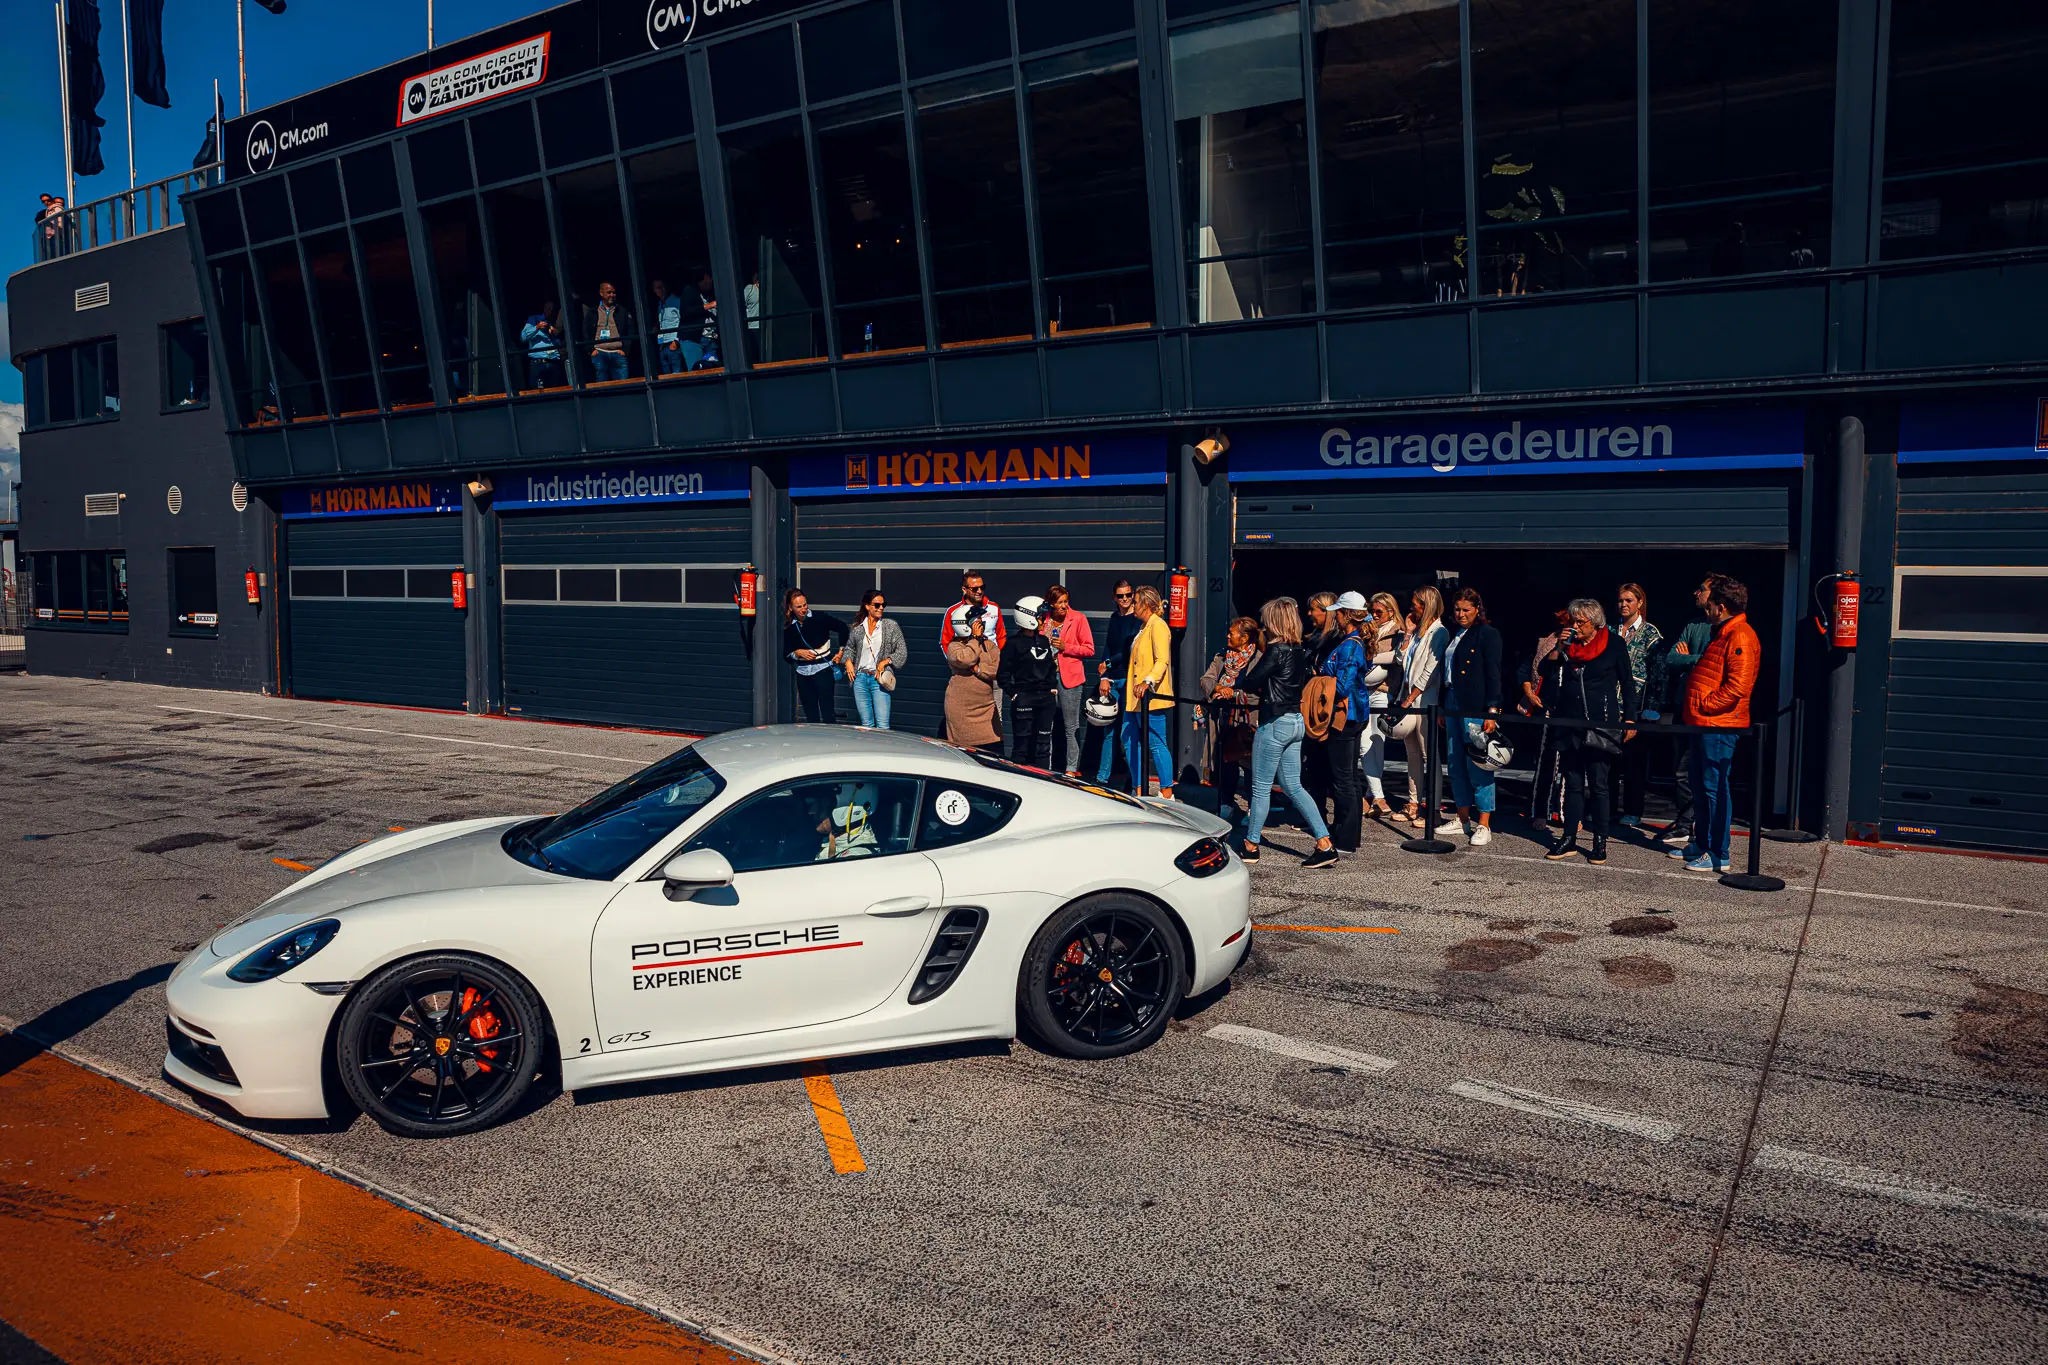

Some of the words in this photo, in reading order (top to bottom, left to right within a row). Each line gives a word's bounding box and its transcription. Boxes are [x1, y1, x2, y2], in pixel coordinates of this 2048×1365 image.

[430, 63, 482, 88] CM.COM
[486, 45, 540, 70] CIRCUIT
[428, 57, 538, 109] ZANDVOORT
[280, 122, 329, 150] CM.com
[1319, 421, 1673, 472] Garagedeuren
[877, 445, 1091, 486] HÖRMANN
[325, 483, 432, 513] HÖRMANN
[527, 470, 703, 503] Industriedeuren
[1210, 577, 1224, 592] 23
[1863, 585, 1885, 604] 22
[1840, 596, 1857, 605] ajax
[631, 924, 839, 961] PORSCHE
[632, 965, 742, 991] EXPERIENCE
[579, 1037, 592, 1053] 2
[607, 1030, 652, 1045] GTS
